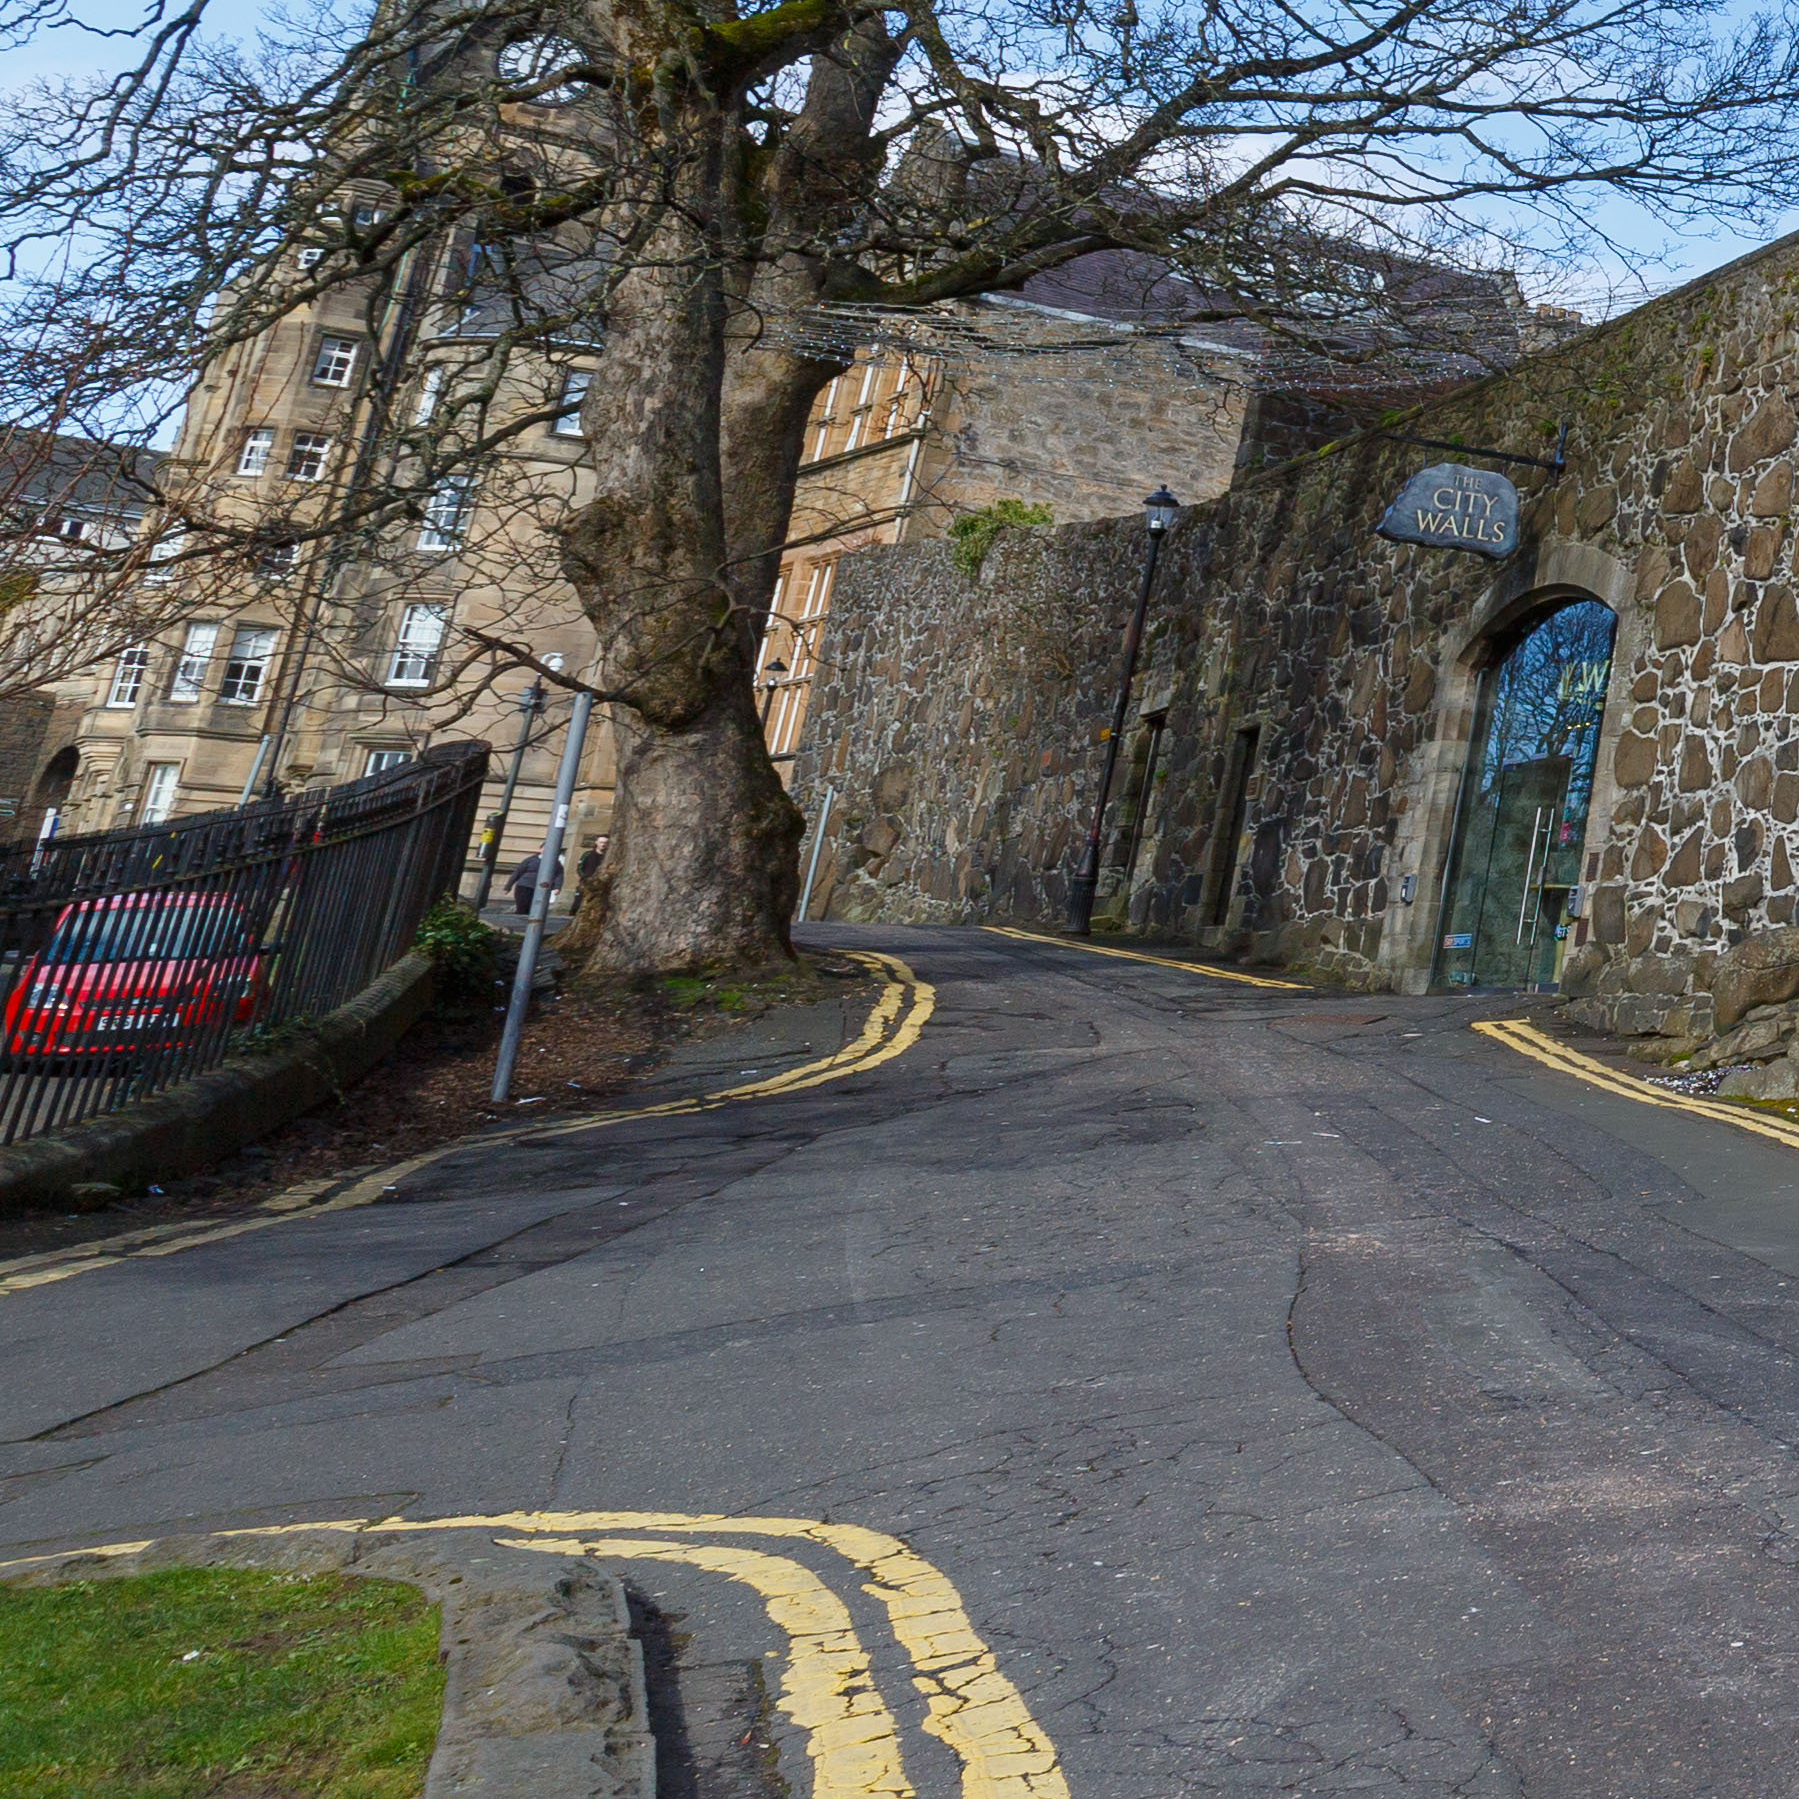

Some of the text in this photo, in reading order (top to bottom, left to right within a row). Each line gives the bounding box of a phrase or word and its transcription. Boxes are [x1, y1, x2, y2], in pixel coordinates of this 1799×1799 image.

[1454, 475, 1482, 489] THE
[1433, 488, 1499, 518] CITY
[1416, 509, 1506, 543] WALLS
